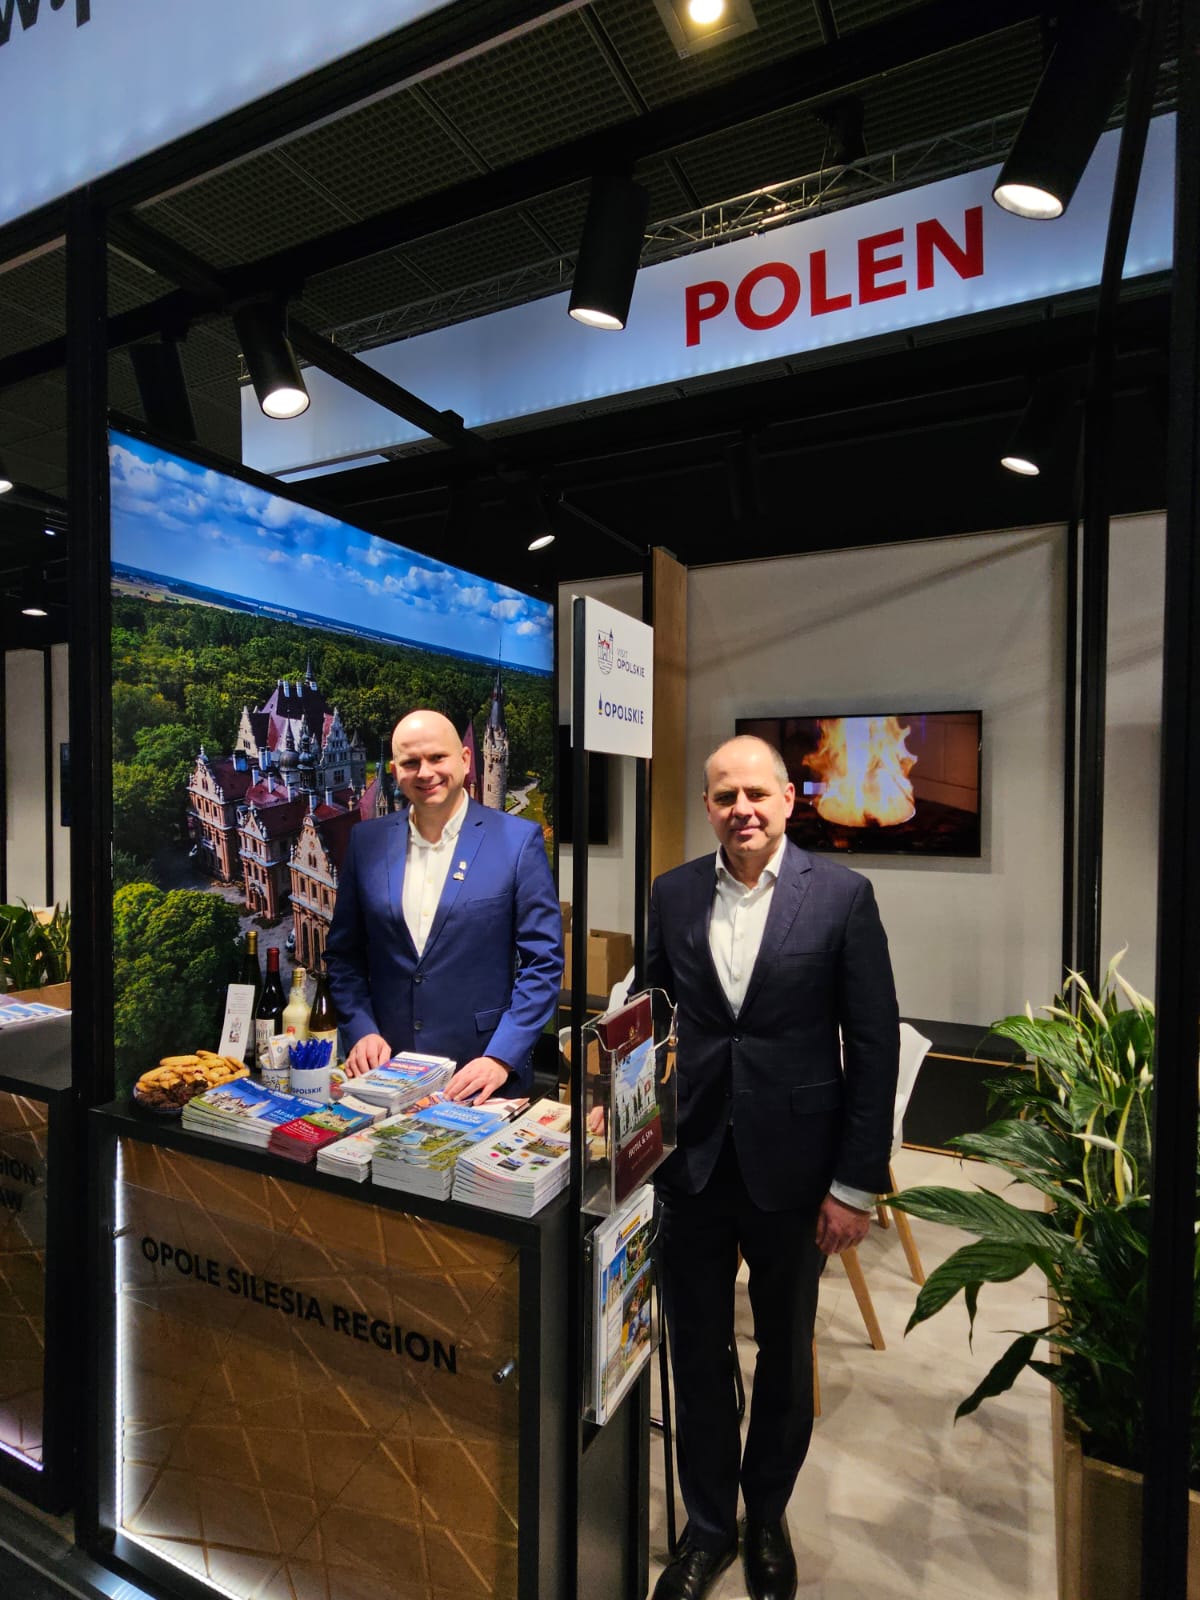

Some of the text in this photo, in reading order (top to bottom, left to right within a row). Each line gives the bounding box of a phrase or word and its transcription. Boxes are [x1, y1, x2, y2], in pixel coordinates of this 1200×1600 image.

[685, 205, 984, 347] POLEN
[617, 658, 645, 678] OPOLSKIE
[604, 701, 644, 725] OPOLSKIE
[141, 1236, 458, 1375] OPOLE SILESIA REGION
